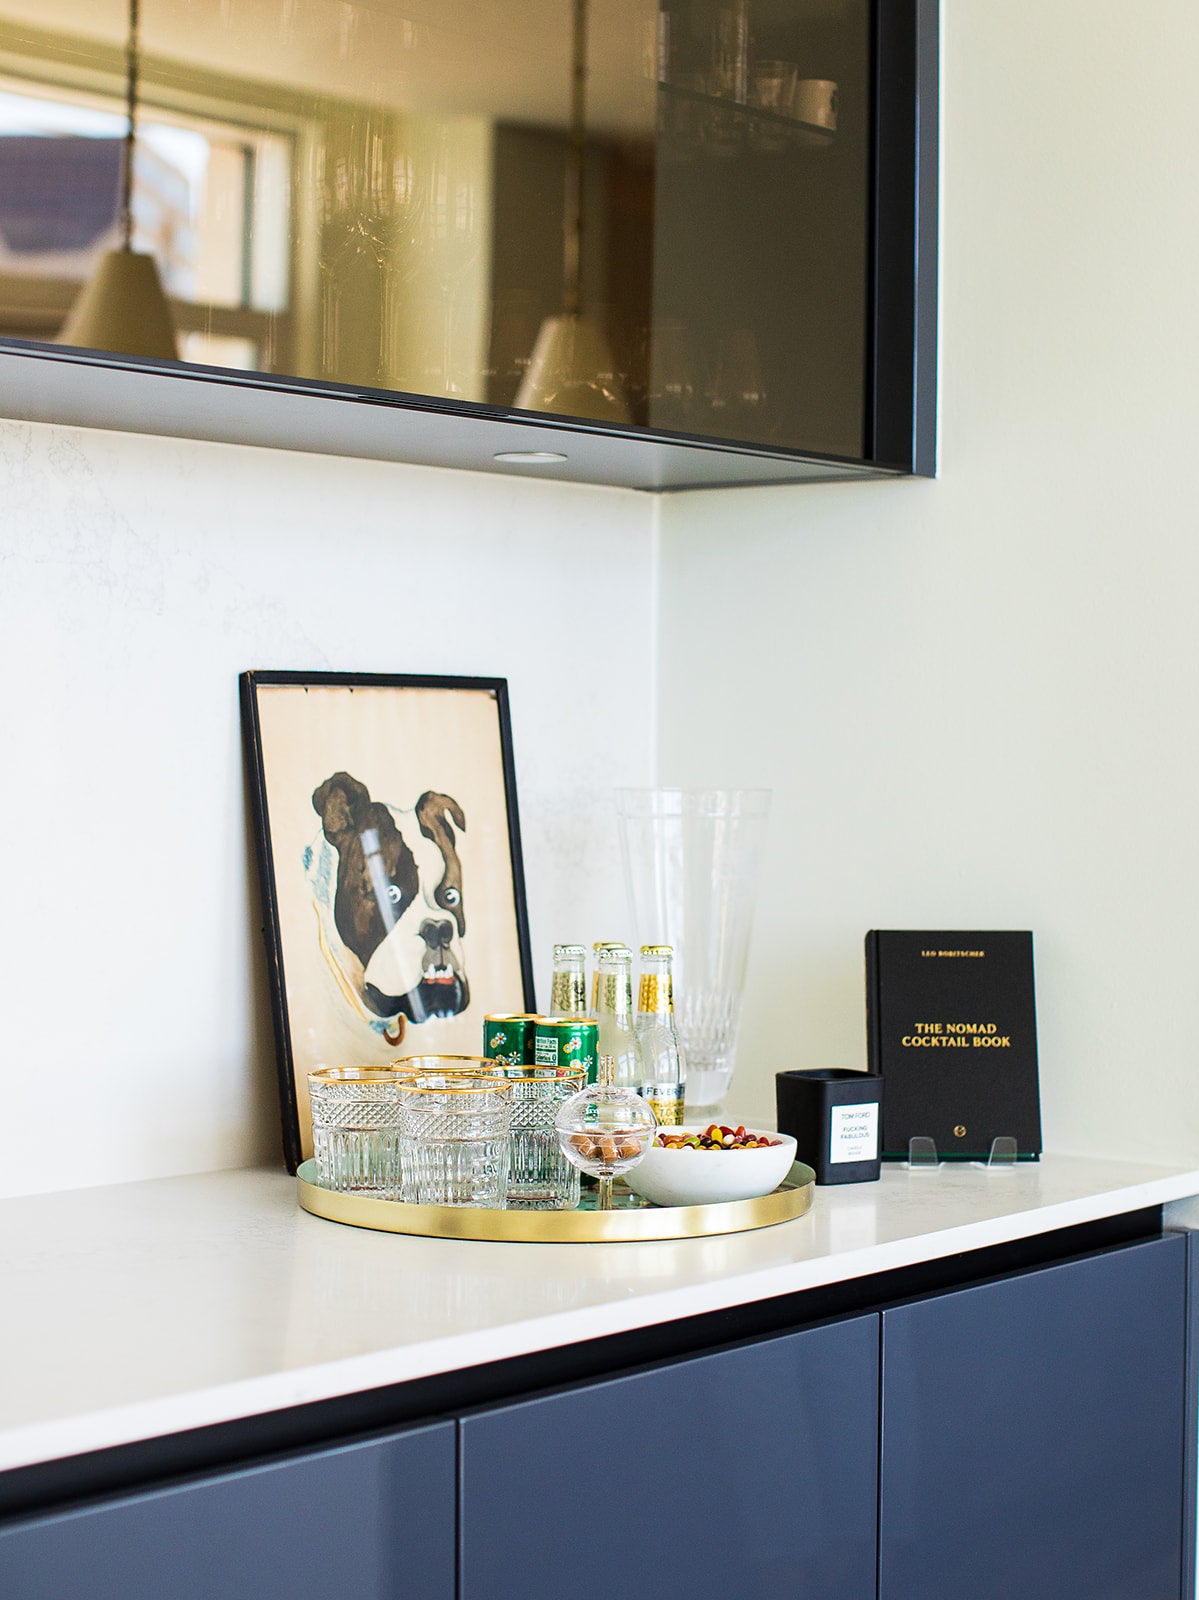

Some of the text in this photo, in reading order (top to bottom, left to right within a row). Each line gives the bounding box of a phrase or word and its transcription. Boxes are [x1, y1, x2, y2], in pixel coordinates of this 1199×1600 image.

[914, 1023, 997, 1034] THE NOMAD
[901, 1036, 1011, 1047] COCKTAIL BOOK
